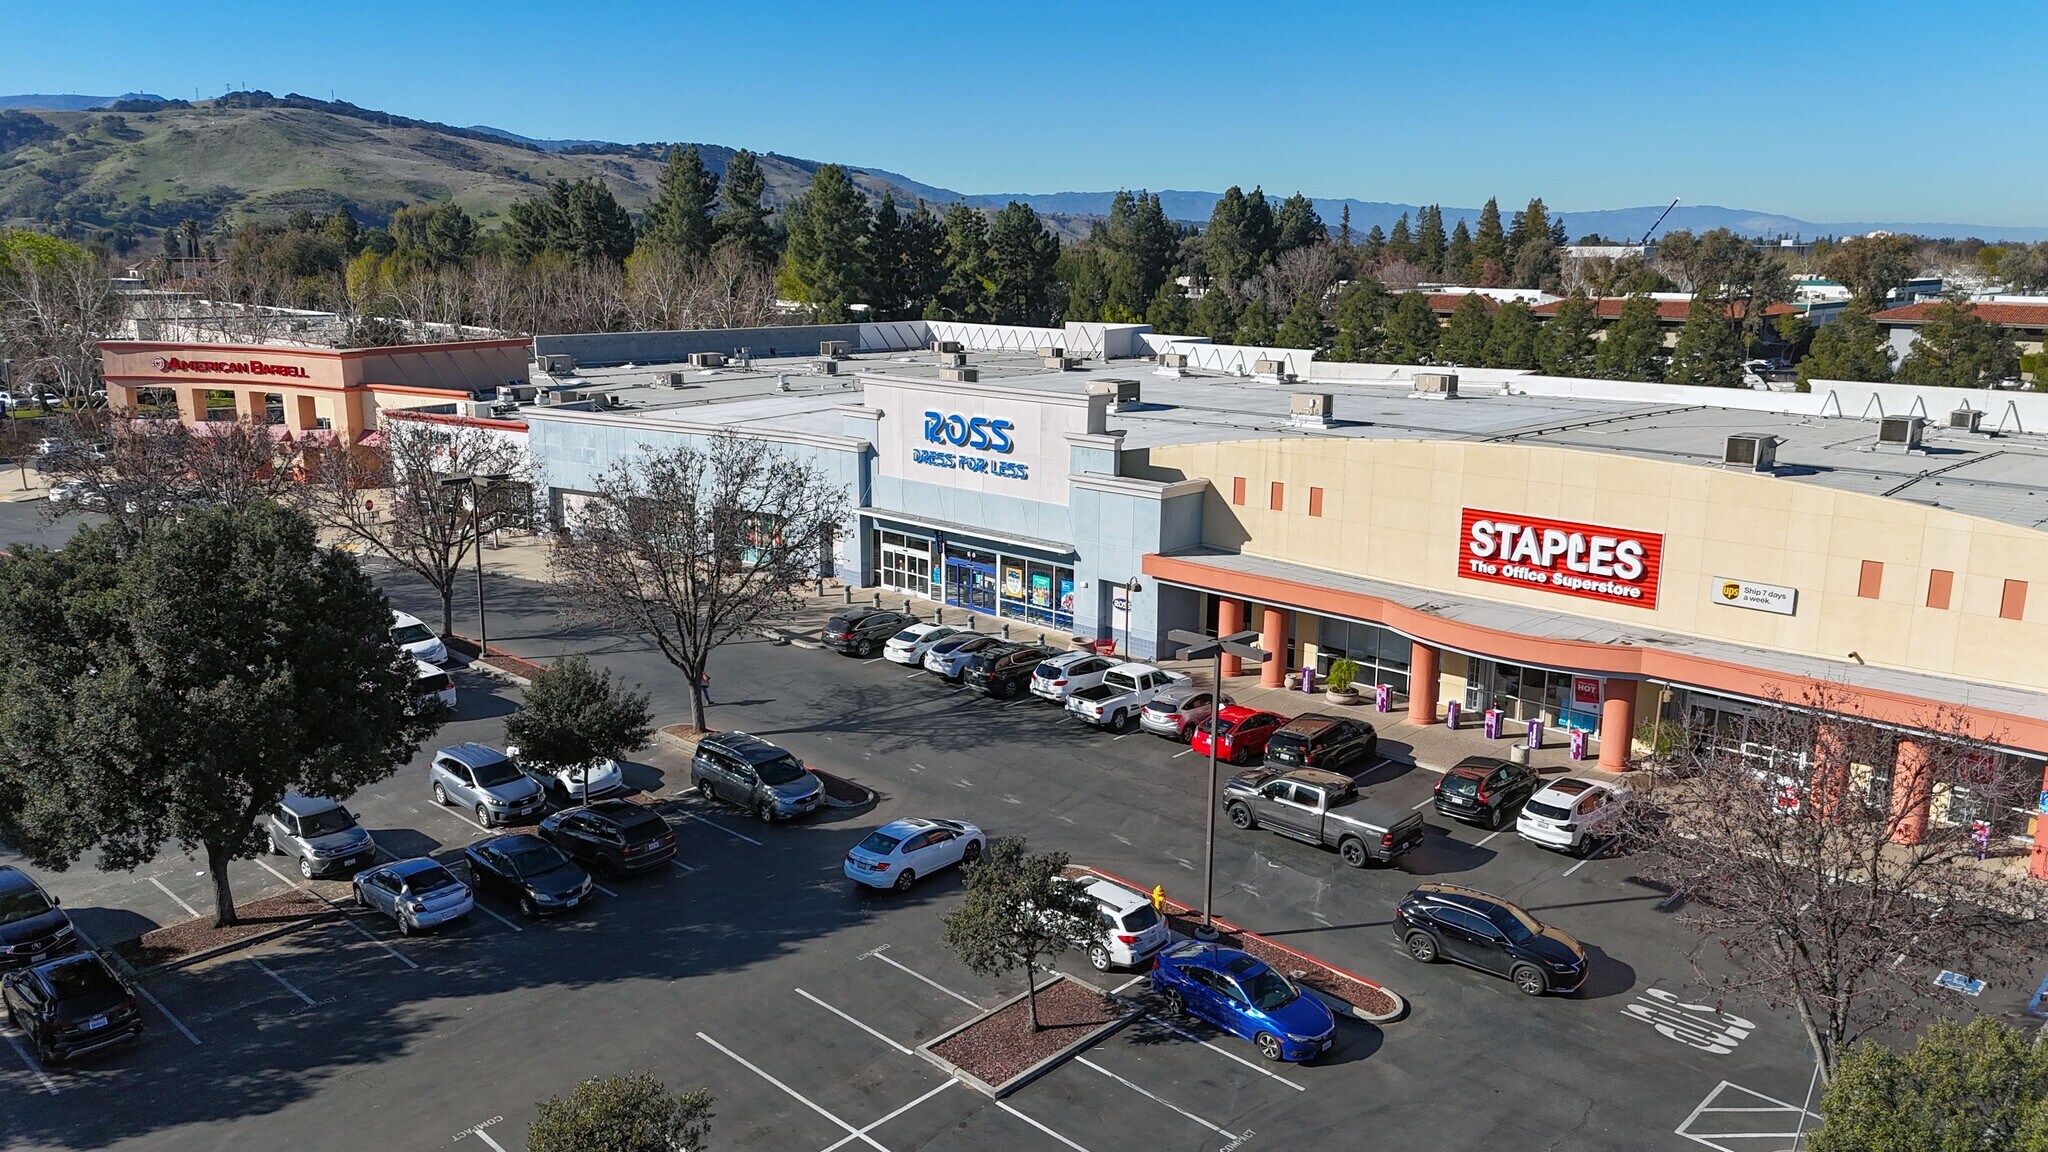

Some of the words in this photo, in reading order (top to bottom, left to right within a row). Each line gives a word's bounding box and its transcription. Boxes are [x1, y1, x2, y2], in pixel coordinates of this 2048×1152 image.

[167, 357, 249, 374] AMERICAN
[250, 360, 310, 379] BARBELL
[924, 411, 1013, 454] ROSS
[912, 449, 955, 469] DRESS
[958, 455, 988, 474] FOR
[990, 460, 1028, 480] LESS
[1469, 519, 1646, 580] STAPLES
[1469, 559, 1498, 575] The
[1502, 564, 1548, 583] Office
[1552, 572, 1642, 598] Superstore
[1723, 586, 1739, 598] ups
[1743, 587, 1761, 596] Ship
[1768, 590, 1786, 600] days
[1750, 596, 1771, 604] week.
[1577, 683, 1596, 694] HOT
[451, 1115, 504, 1142] COMPACT
